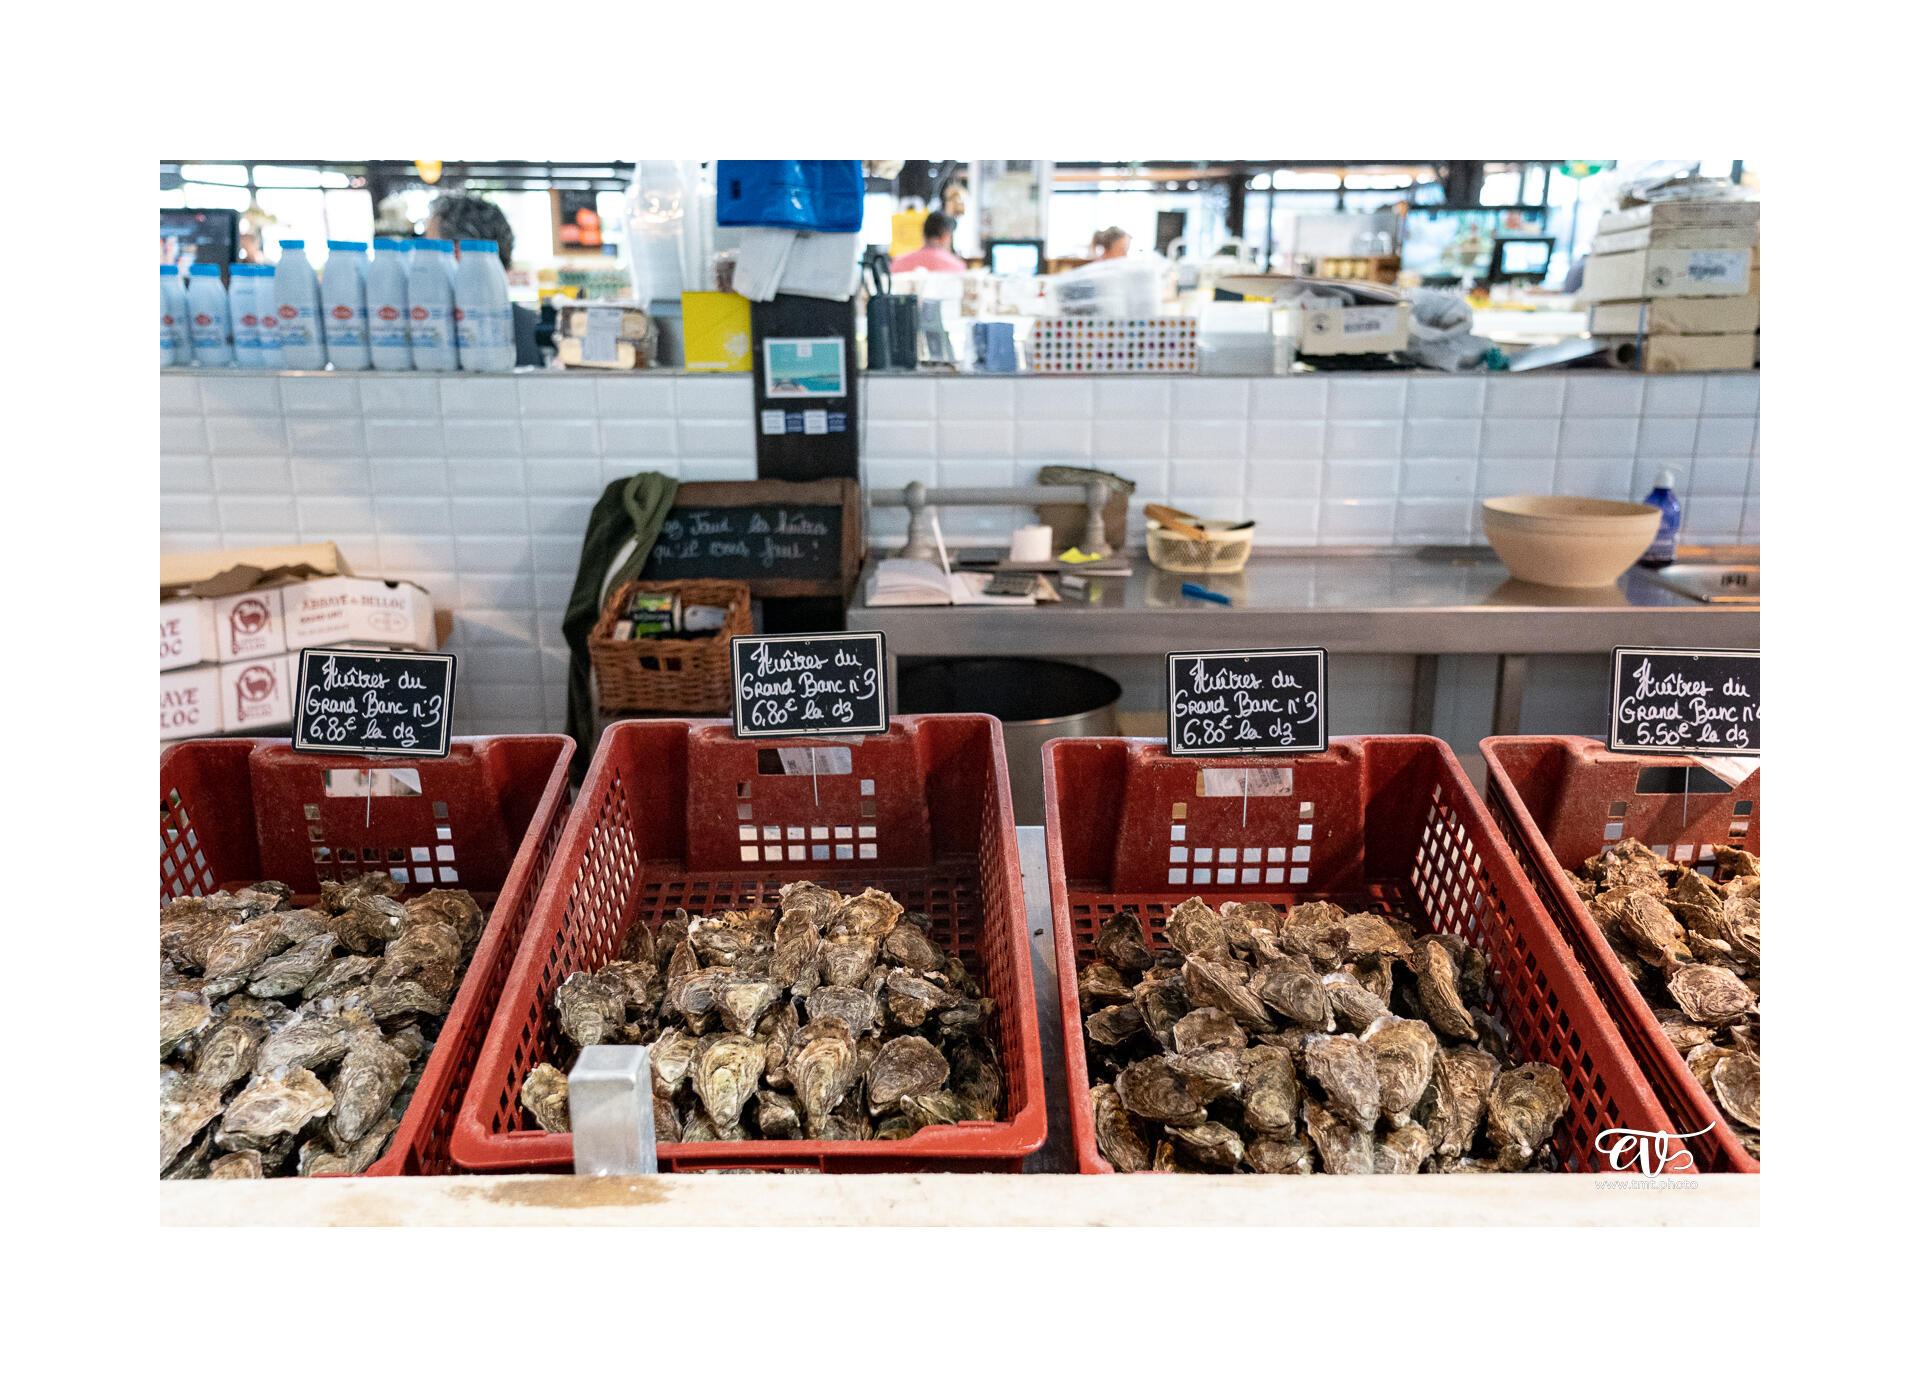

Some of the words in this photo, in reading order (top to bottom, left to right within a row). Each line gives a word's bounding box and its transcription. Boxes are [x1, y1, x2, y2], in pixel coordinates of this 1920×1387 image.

[322, 655, 390, 691] Huîtres
[398, 671, 427, 689] du
[750, 642, 829, 677] Huîtres
[835, 648, 862, 666] du
[741, 672, 796, 700] Grand
[798, 671, 846, 698] Banc
[1189, 658, 1263, 694] Huîtres
[1271, 669, 1302, 689] du
[1632, 657, 1714, 700] Huîtres
[1722, 677, 1751, 697] du
[305, 685, 358, 715] Grand
[362, 690, 408, 718] Banc
[801, 700, 825, 720] la
[832, 698, 854, 723] dz
[1174, 689, 1229, 717] Grand
[1233, 690, 1283, 718] Banc
[1619, 696, 1683, 724] Grand
[1688, 697, 1738, 726] Banc
[360, 718, 387, 740] la
[392, 721, 420, 748] dz
[1233, 719, 1263, 740] la
[1269, 717, 1297, 746] dz
[1696, 723, 1721, 743] la
[1725, 723, 1750, 749] dz
